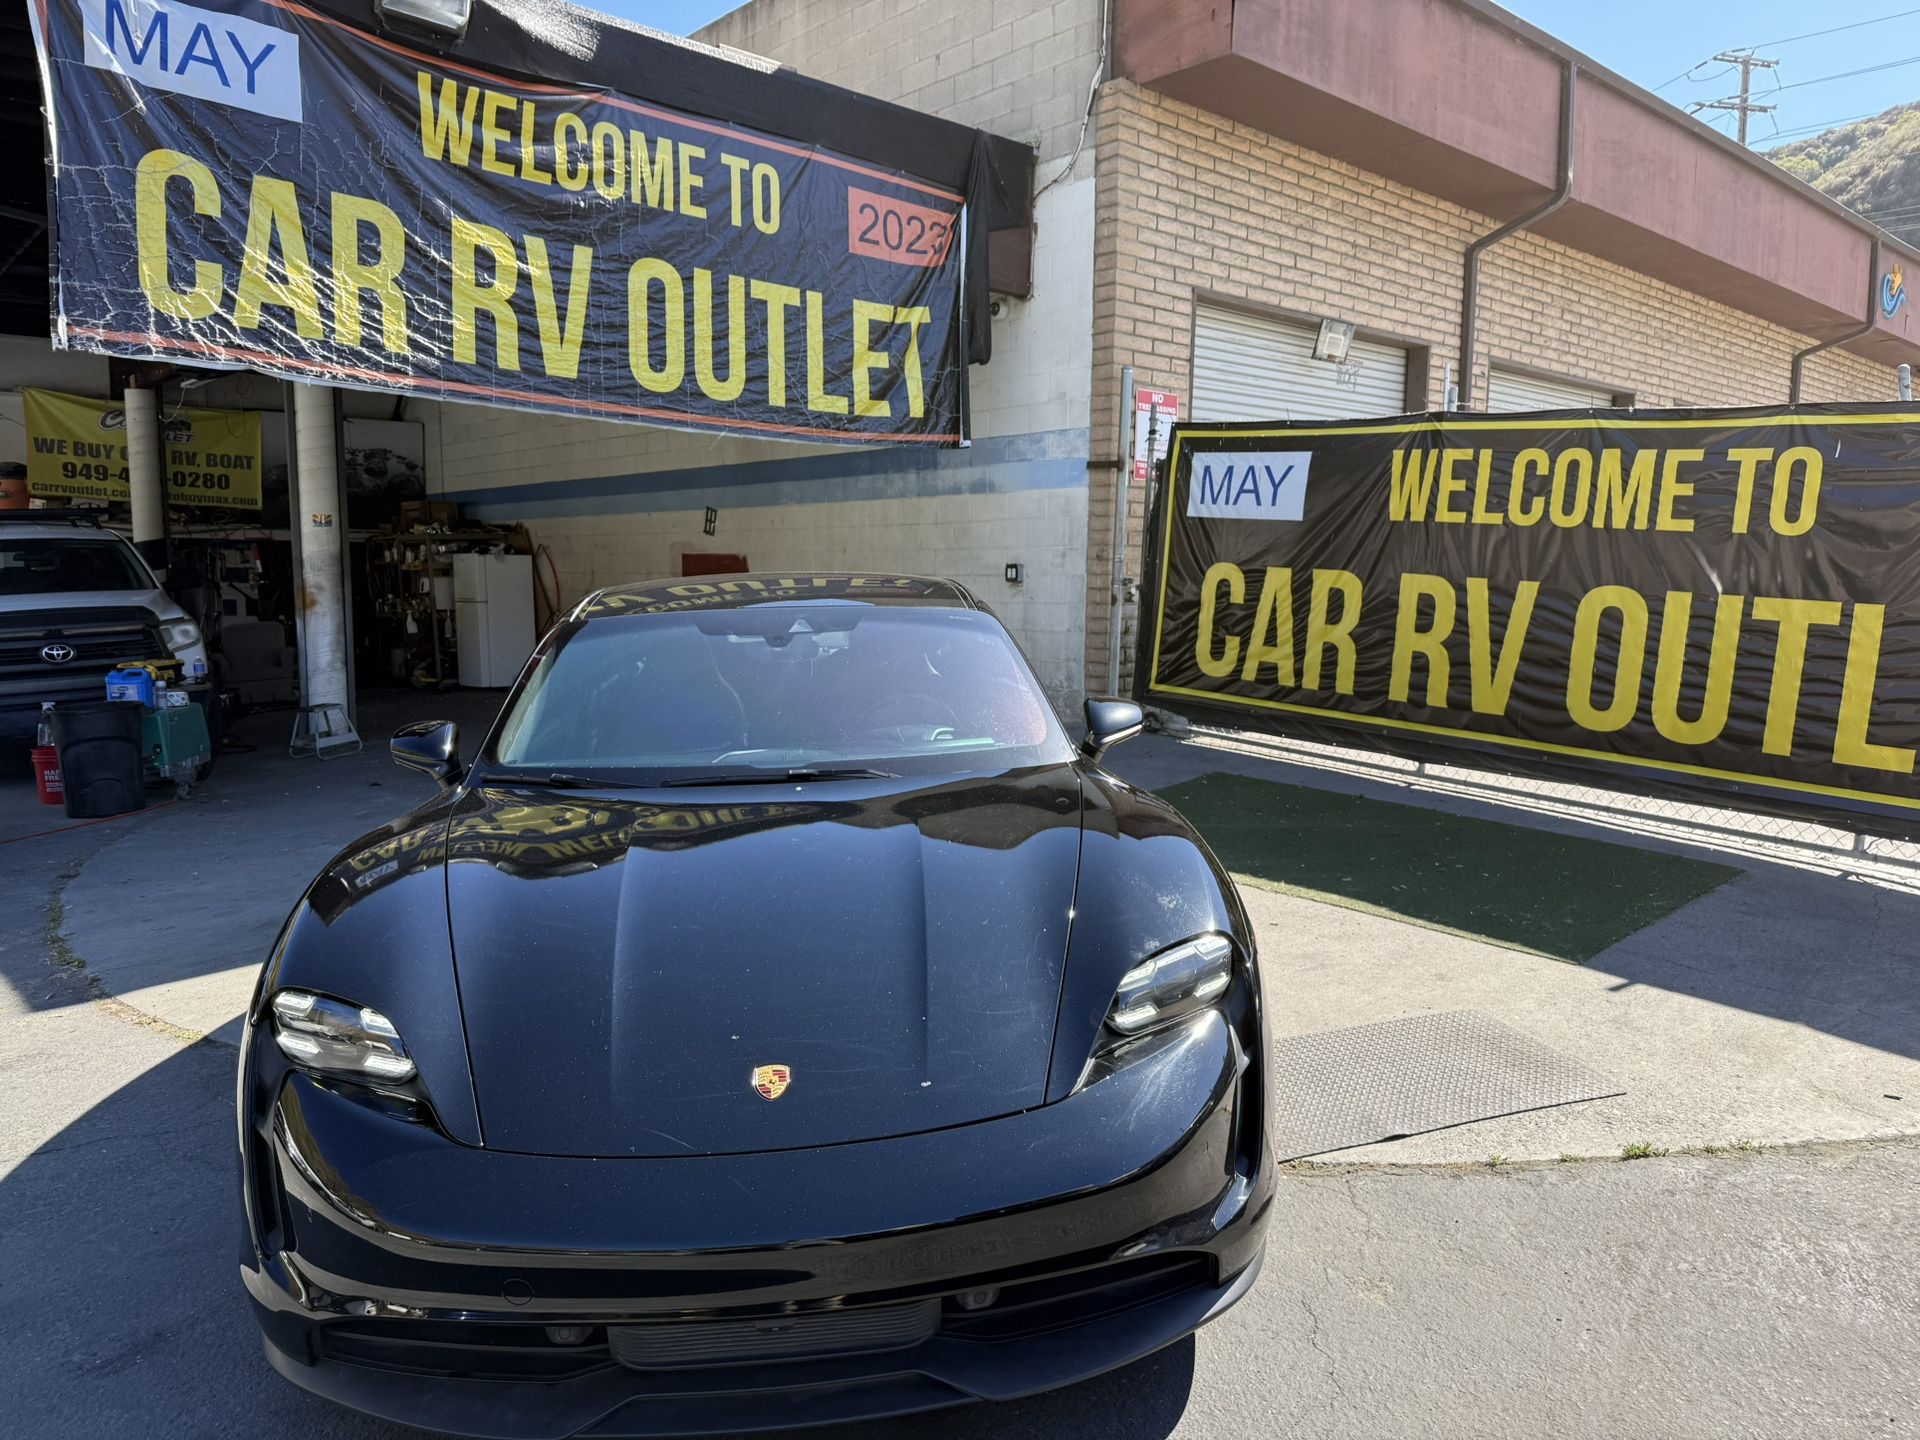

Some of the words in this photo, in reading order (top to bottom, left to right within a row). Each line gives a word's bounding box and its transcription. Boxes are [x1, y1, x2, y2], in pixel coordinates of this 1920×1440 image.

[105, 0, 277, 95] MAY
[416, 71, 709, 219] WELCOME
[719, 152, 782, 235] TO
[858, 203, 948, 257] 2023
[135, 149, 406, 357] CAR
[451, 216, 592, 380] RV
[628, 257, 931, 420] OUTLET
[1138, 402, 1176, 414] TRESASSING
[1151, 393, 1164, 403] NO
[33, 437, 68, 455] WE
[73, 441, 114, 460] BUY
[206, 453, 255, 470] BOAT
[62, 461, 230, 490] 949-4-0280
[1200, 465, 1294, 508] MAY
[1390, 448, 1704, 533] WELCOME
[1728, 446, 1824, 536] TO
[1195, 562, 1364, 697] CAR
[1388, 573, 1540, 716] RV
